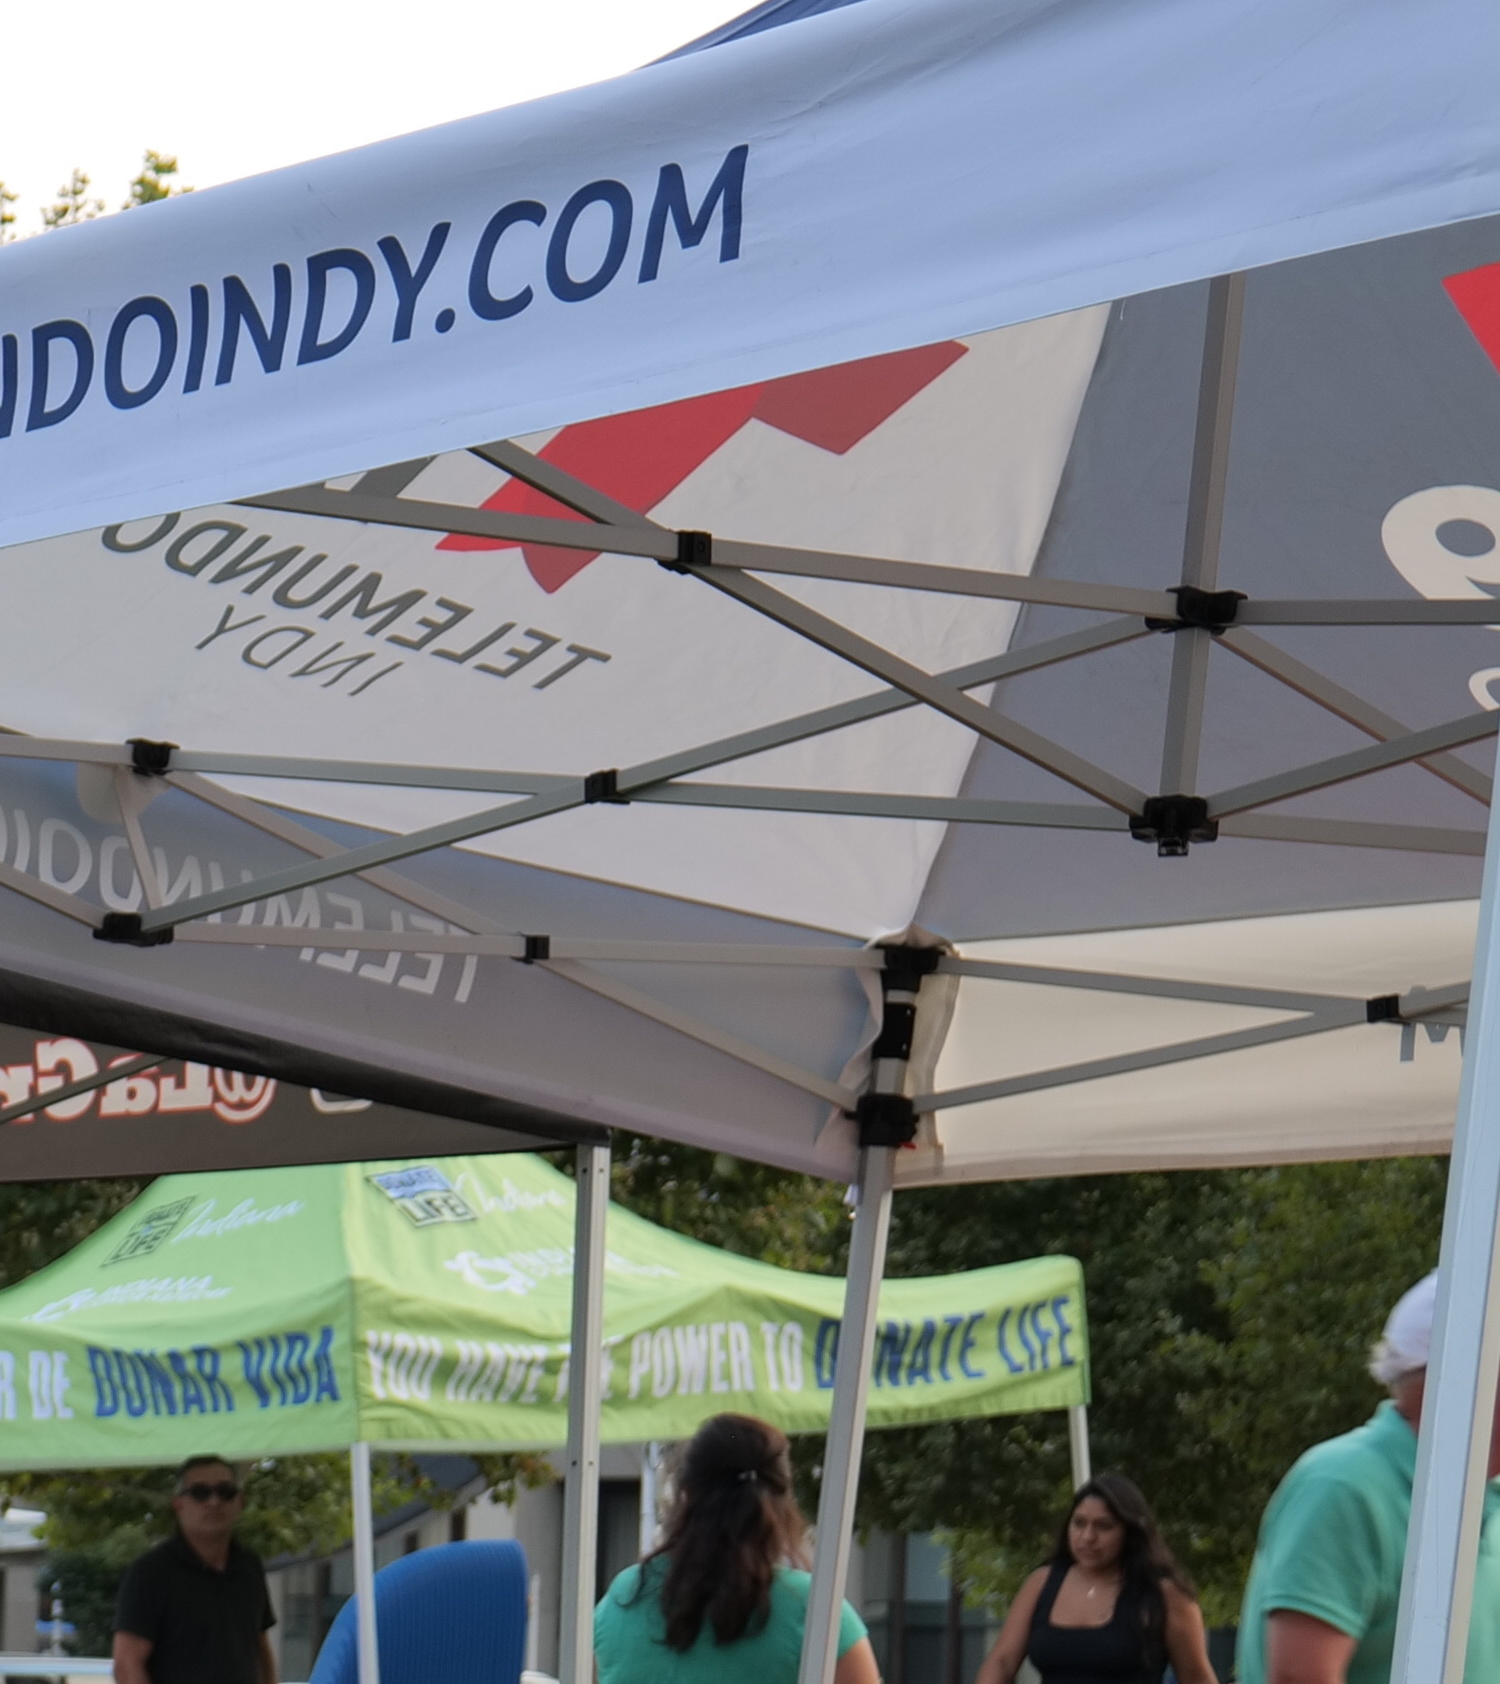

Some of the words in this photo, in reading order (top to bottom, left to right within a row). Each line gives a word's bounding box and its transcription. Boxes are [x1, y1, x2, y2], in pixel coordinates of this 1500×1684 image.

[29, 1350, 76, 1420] DE
[86, 1344, 235, 1419] DONAR
[237, 1325, 341, 1409] VIDA
[366, 1329, 443, 1401] YOU
[446, 1338, 550, 1404] HAVE
[553, 1334, 626, 1404] TE
[629, 1320, 756, 1399] POWER
[760, 1319, 804, 1393] TO
[813, 1310, 997, 1390] DNATE
[996, 1295, 1073, 1375] LIFE
